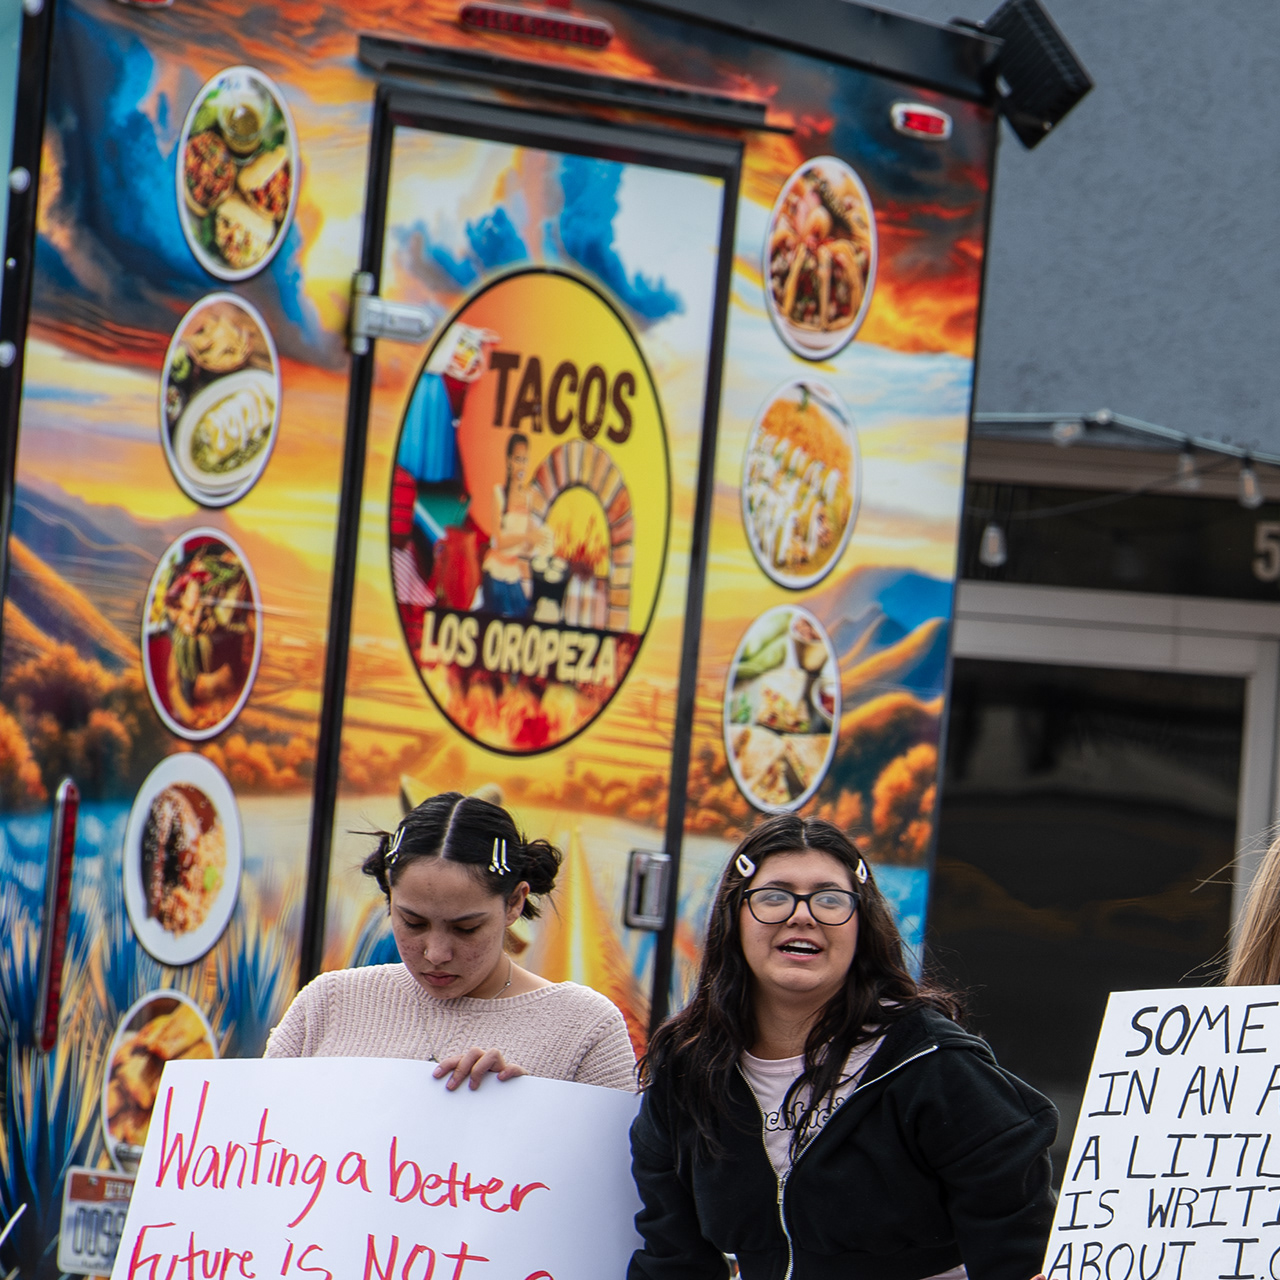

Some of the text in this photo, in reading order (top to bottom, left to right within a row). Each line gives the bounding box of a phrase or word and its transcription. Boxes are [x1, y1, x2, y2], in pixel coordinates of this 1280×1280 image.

[489, 351, 637, 444] TACOS
[420, 610, 618, 687] LOS OROPEZA
[1088, 1066, 1160, 1118] IN
[1177, 1064, 1240, 1119] AN
[155, 1080, 551, 1228] Wanting a better
[1072, 1134, 1101, 1181] A
[1058, 1188, 1120, 1232] IS
